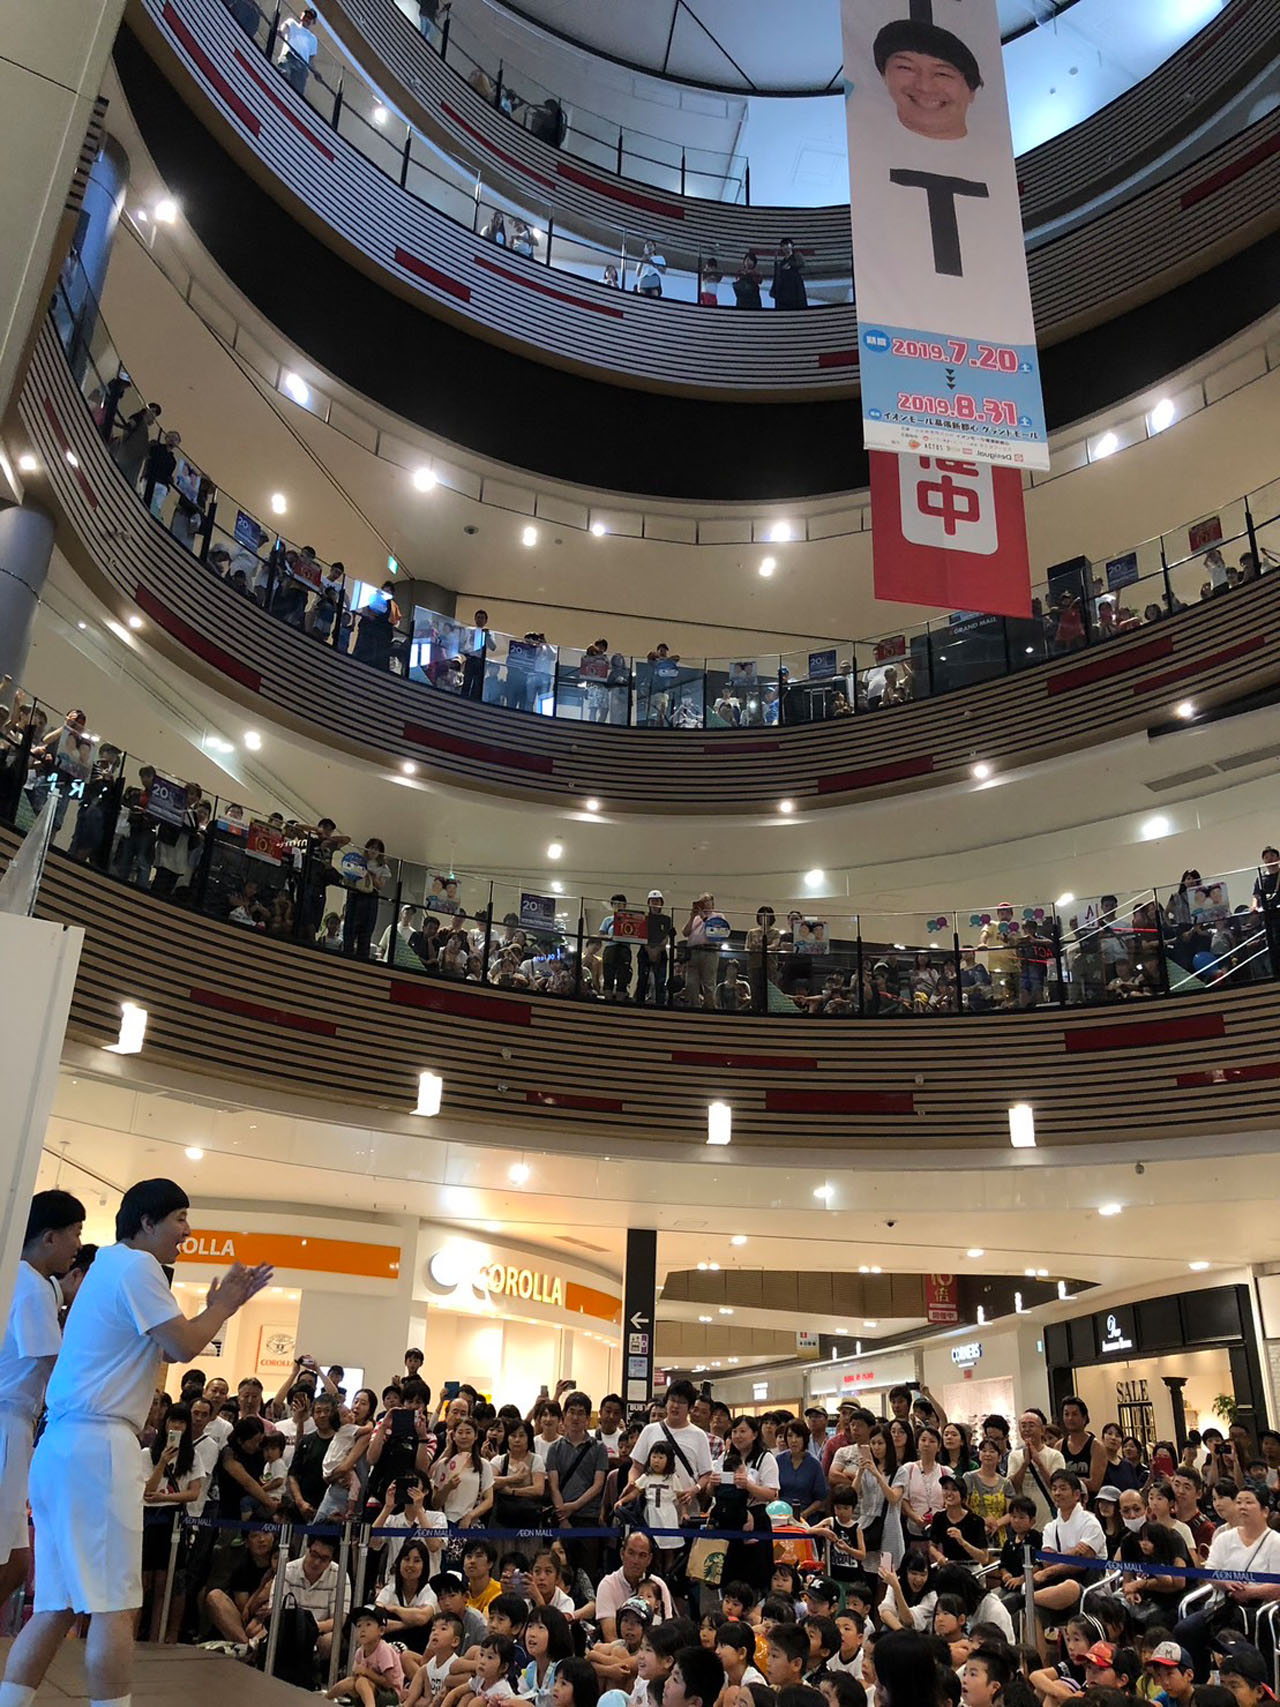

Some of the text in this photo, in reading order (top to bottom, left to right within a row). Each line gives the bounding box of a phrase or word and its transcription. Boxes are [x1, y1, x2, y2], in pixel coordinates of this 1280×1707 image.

[889, 168, 989, 278] T
[892, 339, 1019, 373] 2019.7.20
[898, 392, 1018, 426] 2019.8.31
[1116, 1379, 1149, 1402] SALE
[648, 1484, 669, 1508] T
[434, 1529, 453, 1537] MALL
[535, 1529, 553, 1537] MALL
[1123, 1563, 1143, 1573] MALL
[1233, 1572, 1256, 1582] MALL
